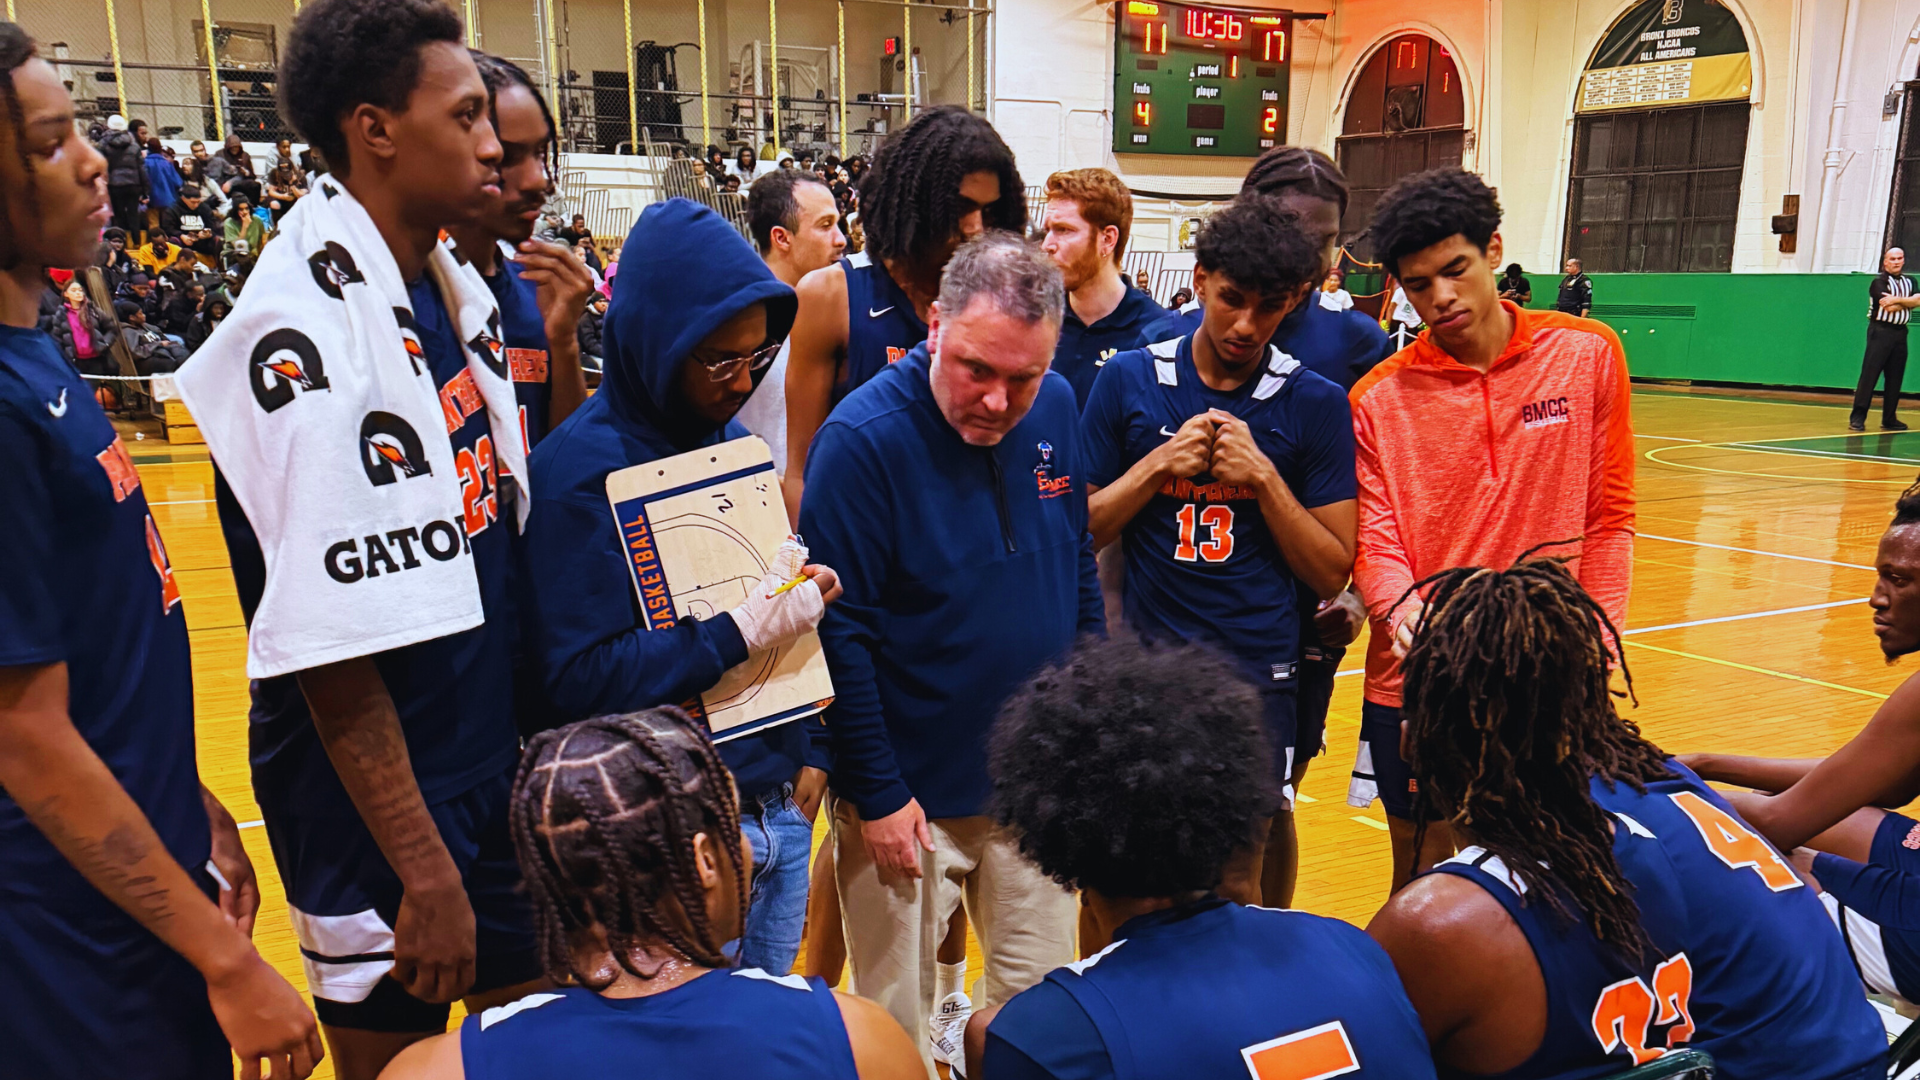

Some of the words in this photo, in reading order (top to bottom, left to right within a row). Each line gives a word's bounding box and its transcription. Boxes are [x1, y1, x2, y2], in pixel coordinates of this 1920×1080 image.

[1146, 22, 1167, 54] 11
[1640, 29, 1665, 42] BRONX
[1666, 26, 1701, 38] BRONCOS
[1656, 38, 1681, 49] NJCAA
[1265, 31, 1285, 61] 17
[1640, 51, 1653, 62] ALL
[1655, 47, 1697, 60] AMERICANS
[1197, 64, 1219, 76] period
[1231, 55, 1237, 77] 1
[1195, 86, 1219, 99] player
[1137, 102, 1150, 126] 4
[1265, 108, 1277, 133] 2
[1133, 134, 1148, 143] won
[1196, 136, 1214, 147] game
[1522, 396, 1569, 424] BMCC
[454, 434, 498, 538] 23
[1174, 503, 1235, 563] 13
[1667, 790, 1805, 892] 4
